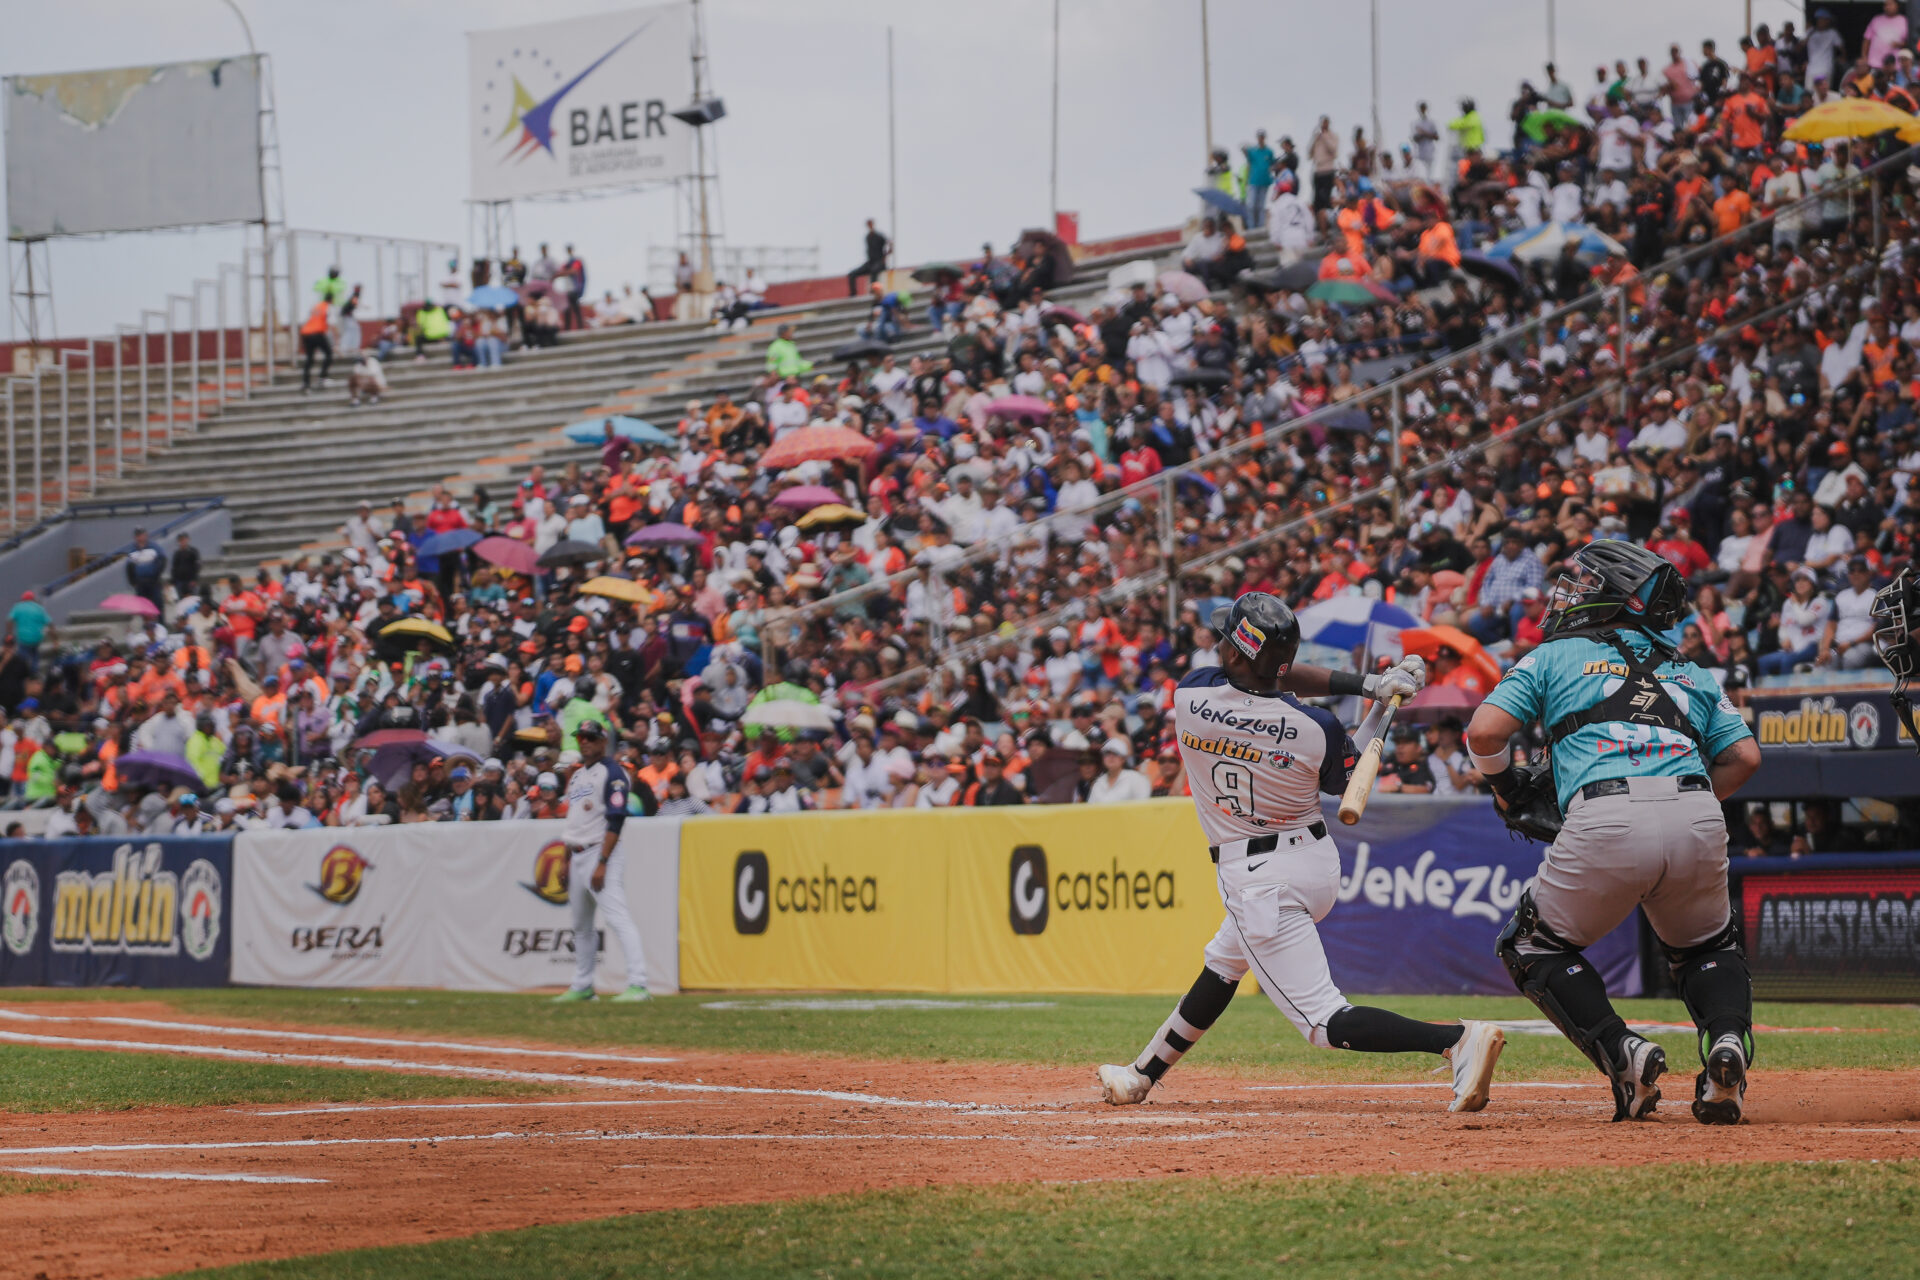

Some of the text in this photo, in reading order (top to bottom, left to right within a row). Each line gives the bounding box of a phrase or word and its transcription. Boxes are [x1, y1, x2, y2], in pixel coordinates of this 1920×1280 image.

[570, 99, 668, 147] BAER
[1276, 663, 1289, 677] 9
[1181, 730, 1263, 763] maltín
[1212, 761, 1255, 818] 9
[776, 862, 877, 914] cashea
[1056, 856, 1175, 911] cashea
